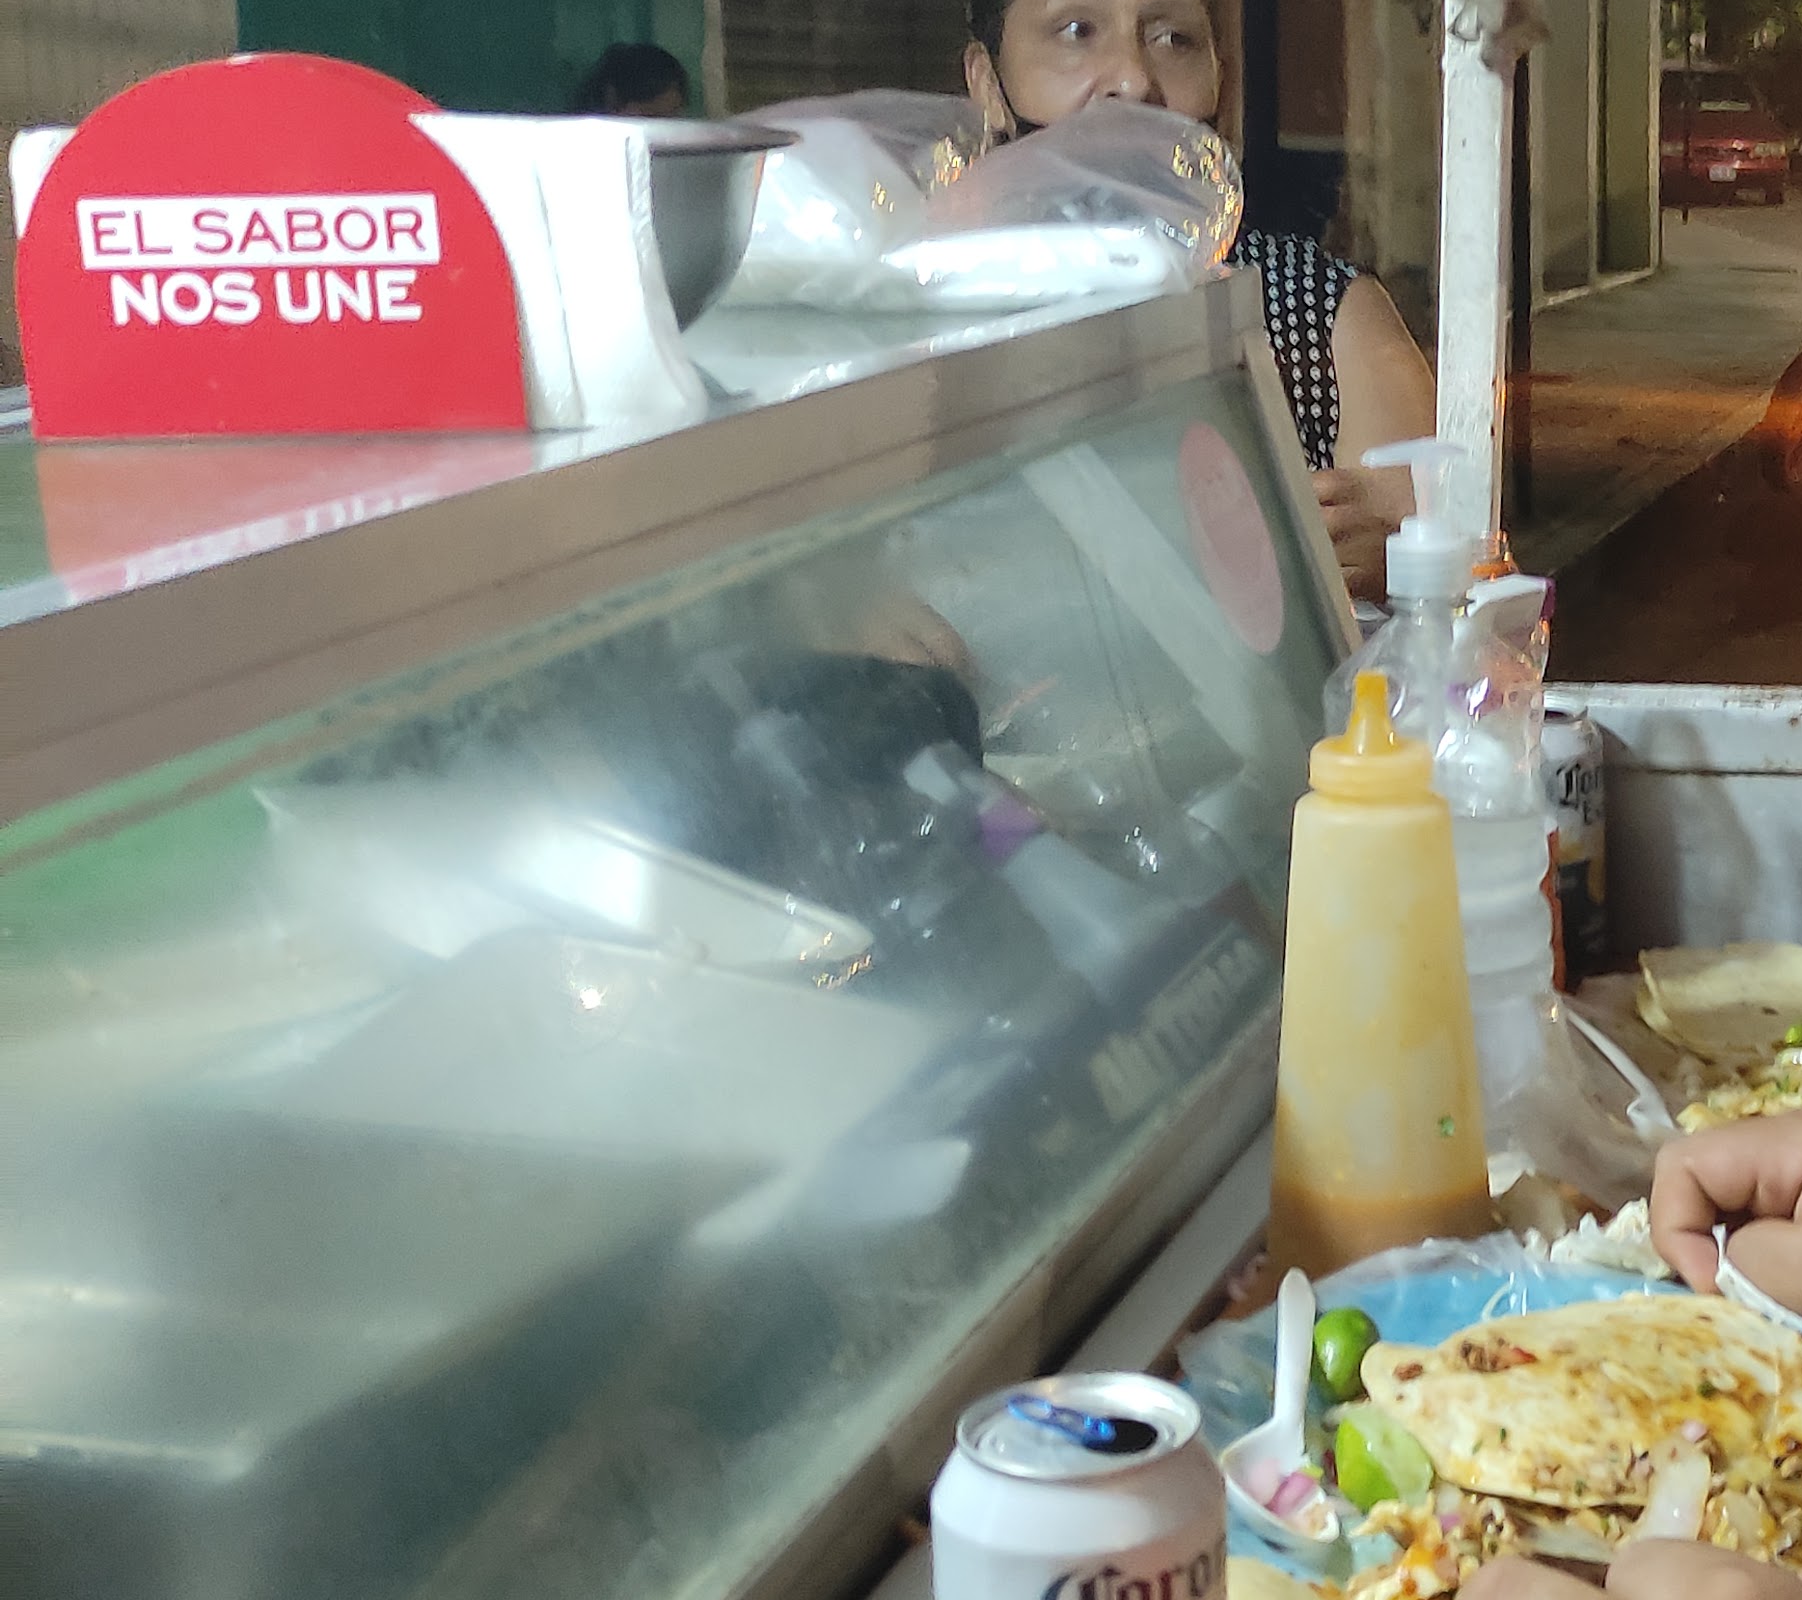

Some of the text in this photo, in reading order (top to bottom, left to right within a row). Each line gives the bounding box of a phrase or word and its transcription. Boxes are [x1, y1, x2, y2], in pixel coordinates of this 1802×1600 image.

[91, 206, 428, 255] EL SABOR
[110, 268, 424, 326] NOS UNE
